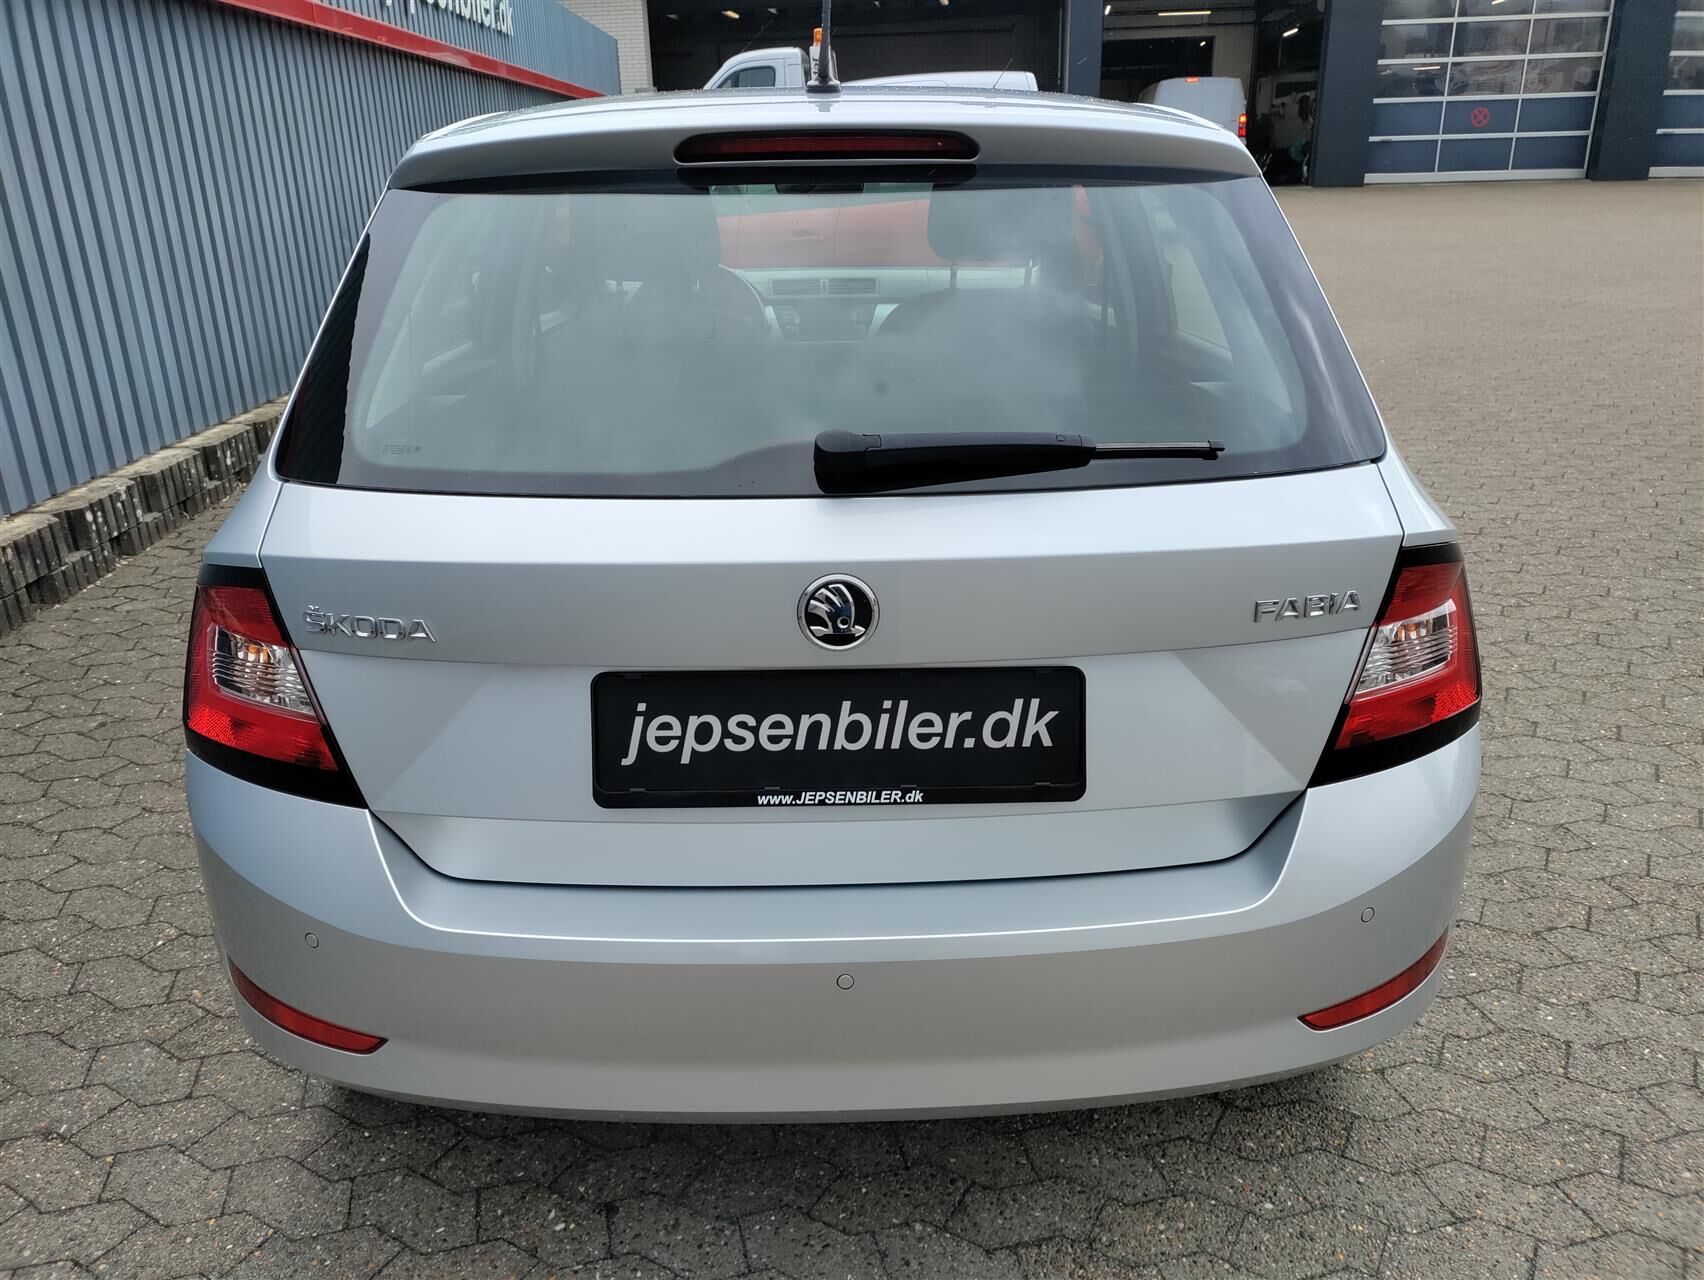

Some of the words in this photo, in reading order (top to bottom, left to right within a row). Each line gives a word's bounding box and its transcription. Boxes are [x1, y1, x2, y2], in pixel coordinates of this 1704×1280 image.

[303, 604, 436, 643] ŠKODA
[1254, 590, 1360, 622] FABIA
[621, 698, 1060, 766] jepsenbiler.dk
[757, 789, 923, 805] www.JEPSENBILER.dk
